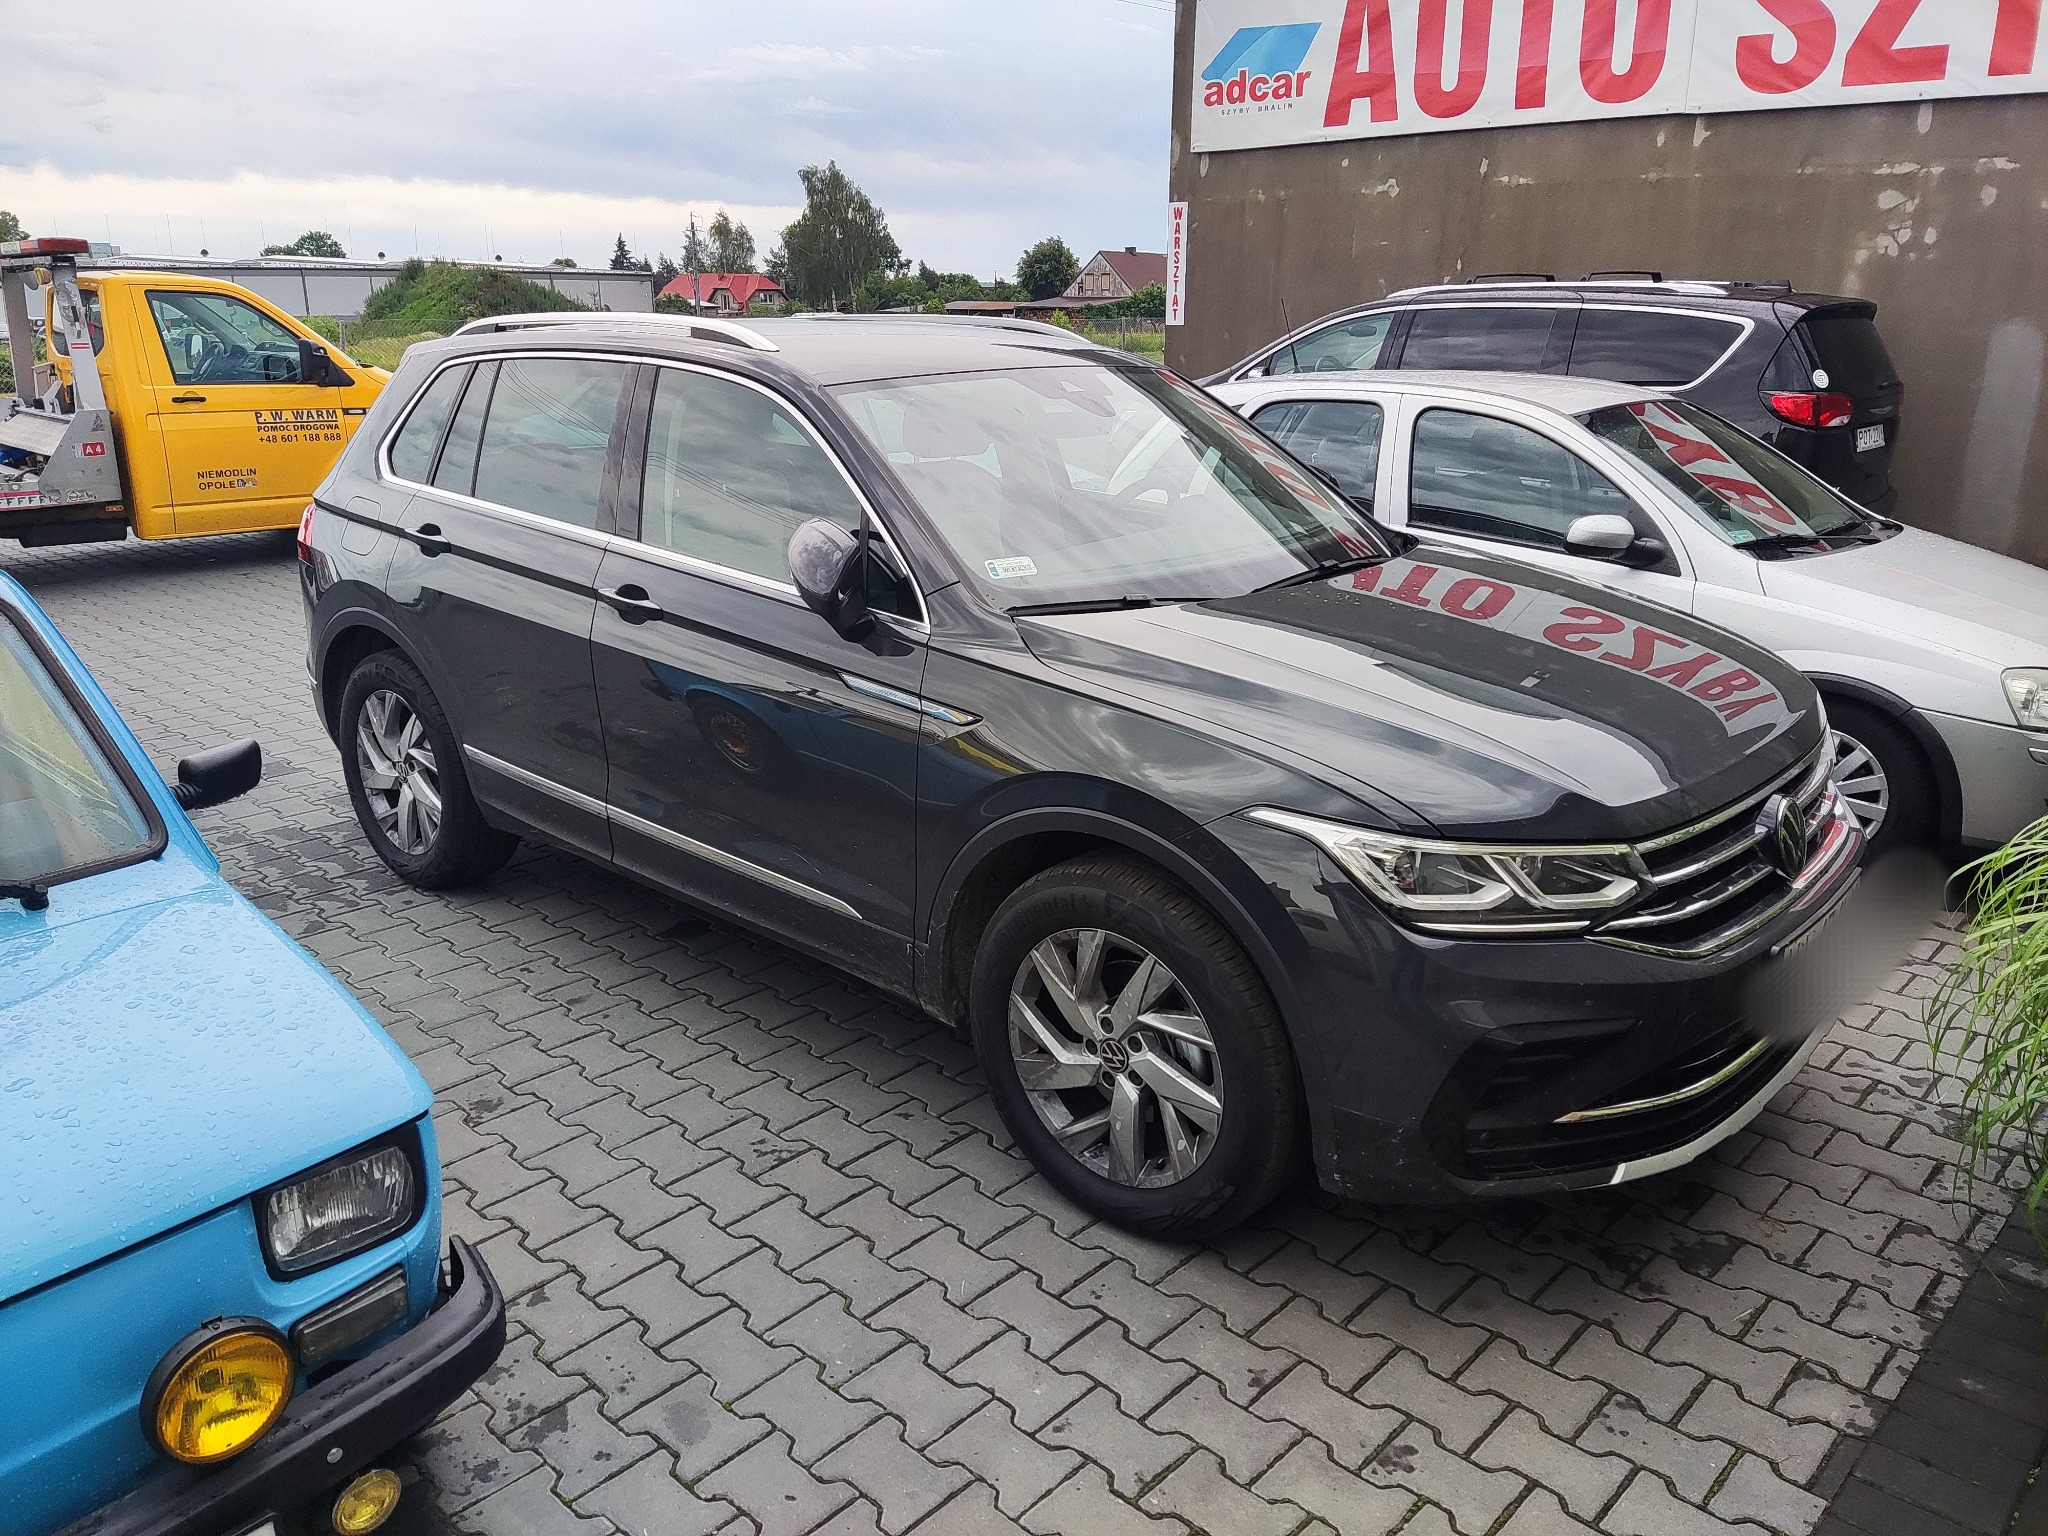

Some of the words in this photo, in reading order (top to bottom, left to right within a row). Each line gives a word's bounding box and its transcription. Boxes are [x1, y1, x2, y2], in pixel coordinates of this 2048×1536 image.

[1203, 70, 1312, 107] adcar
[1221, 106, 1251, 116] SZYBY
[1257, 102, 1294, 113] BRALIN
[1171, 206, 1184, 322] WARSZTAT
[291, 409, 338, 421] WARM
[257, 424, 291, 433] POMOC
[293, 423, 340, 432] DROGOWA
[259, 434, 278, 444] +48
[280, 433, 299, 443] 601
[302, 433, 321, 442] 188
[323, 432, 342, 441] 888
[197, 467, 257, 480] NIEMODLIN
[198, 480, 237, 491] OPOLE
